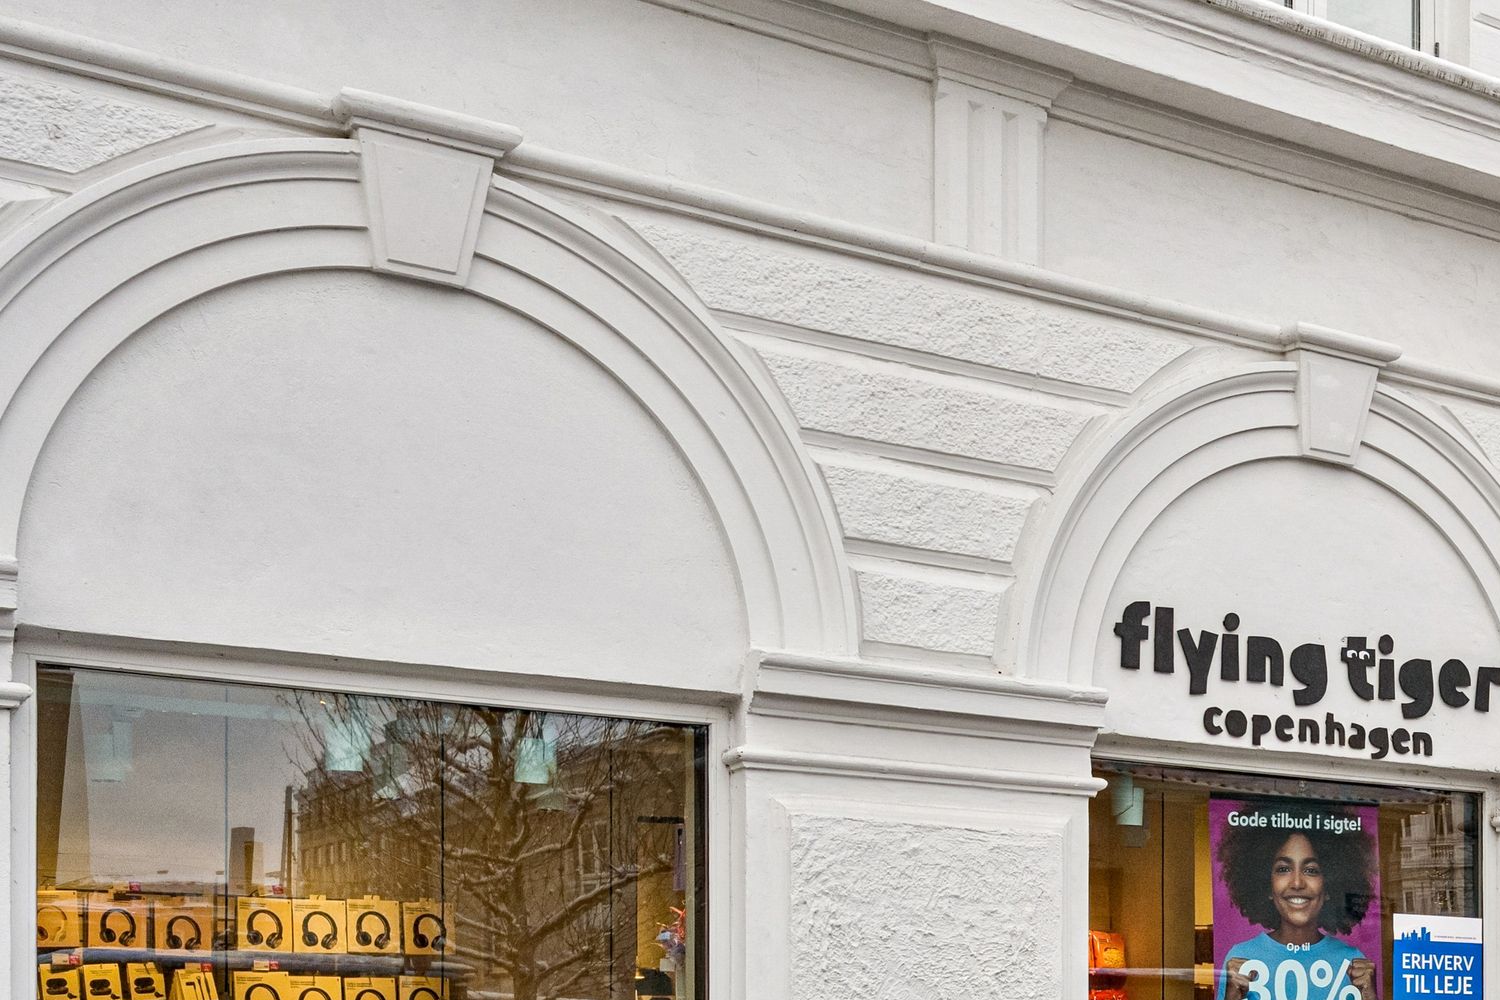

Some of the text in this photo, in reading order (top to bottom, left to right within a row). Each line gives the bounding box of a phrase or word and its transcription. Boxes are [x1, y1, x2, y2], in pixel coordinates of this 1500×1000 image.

[1113, 600, 1328, 706] flying
[1203, 706, 1433, 759] copenhagen
[1228, 811, 1361, 834] Gode tilbud i sigte!
[1287, 942, 1310, 953] Op til
[1402, 953, 1474, 971] ERHVERV
[1402, 974, 1473, 995] TIL LEJE
